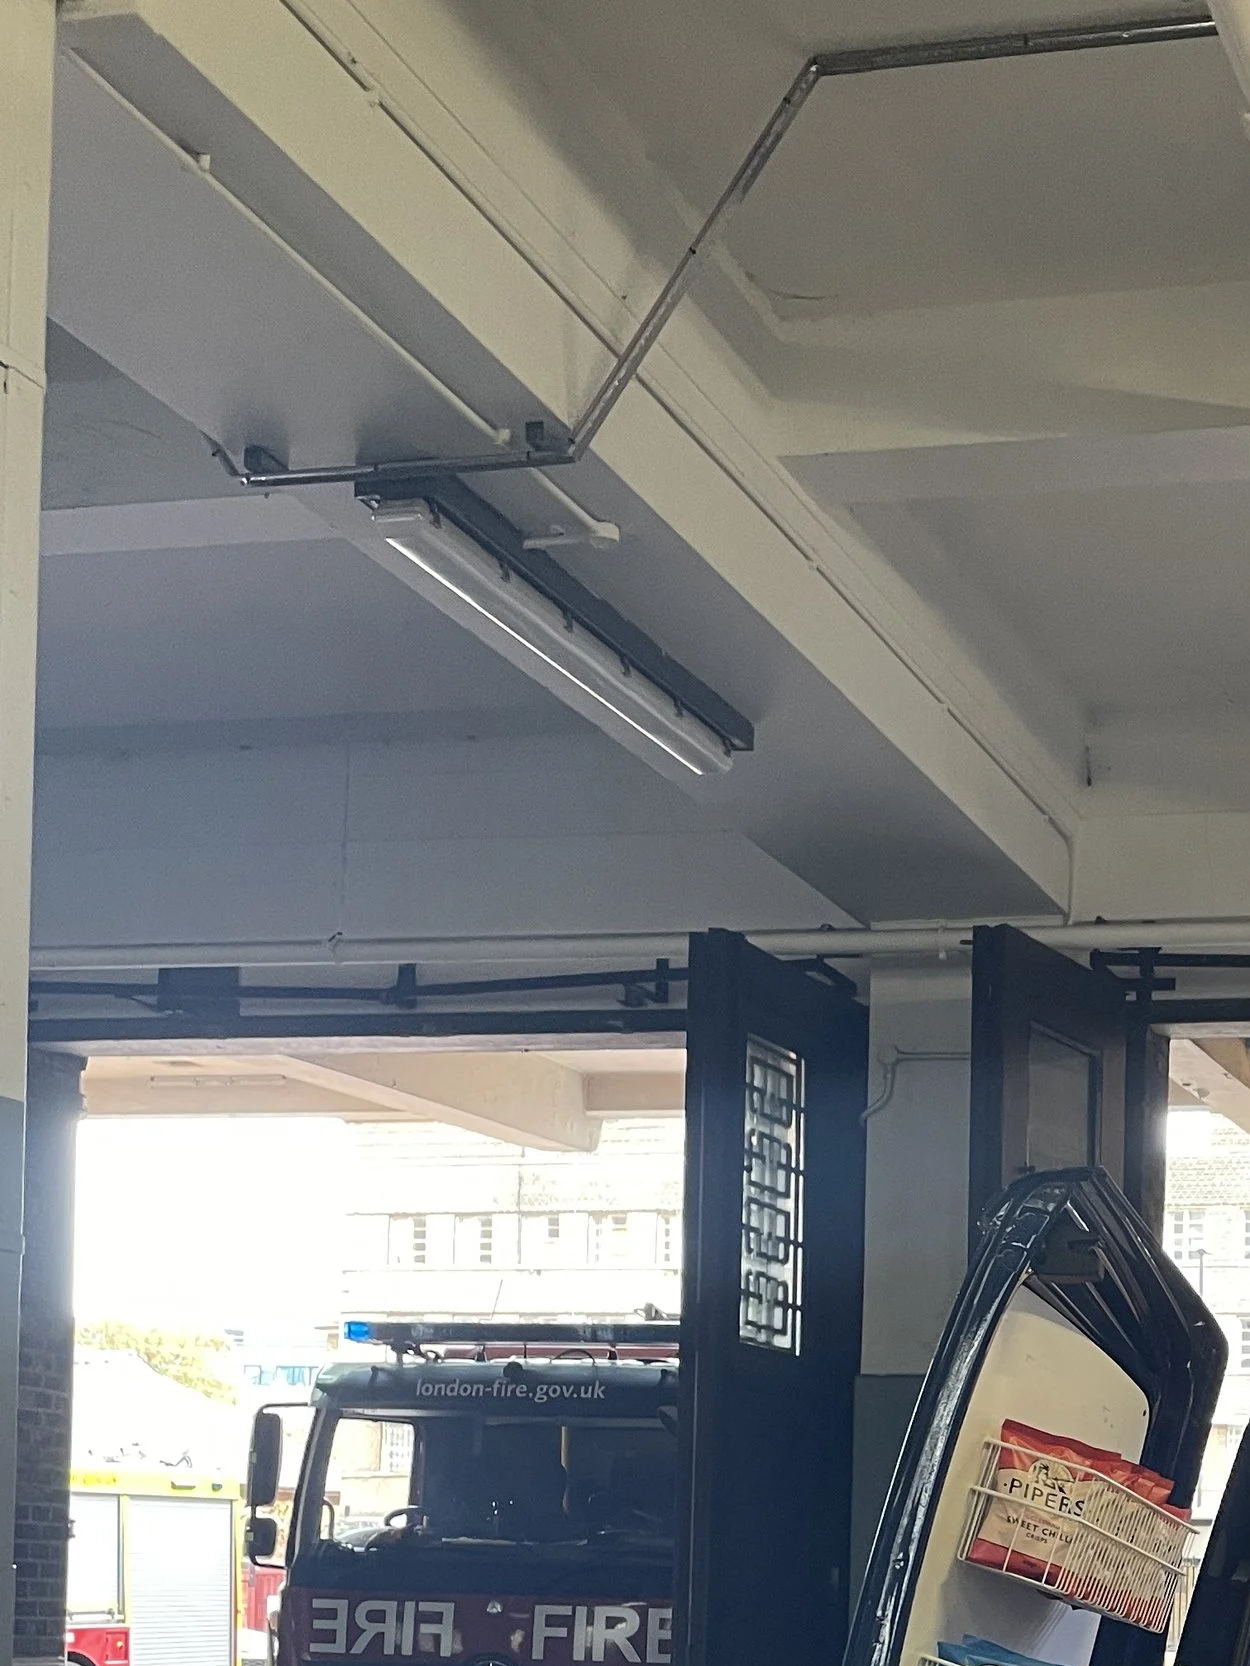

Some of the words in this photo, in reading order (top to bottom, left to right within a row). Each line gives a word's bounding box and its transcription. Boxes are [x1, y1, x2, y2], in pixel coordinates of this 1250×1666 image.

[415, 1378, 606, 1403] london-fire.gov.uk
[1008, 1478, 1085, 1517] PIPERS
[531, 1603, 673, 1664] FIRE
